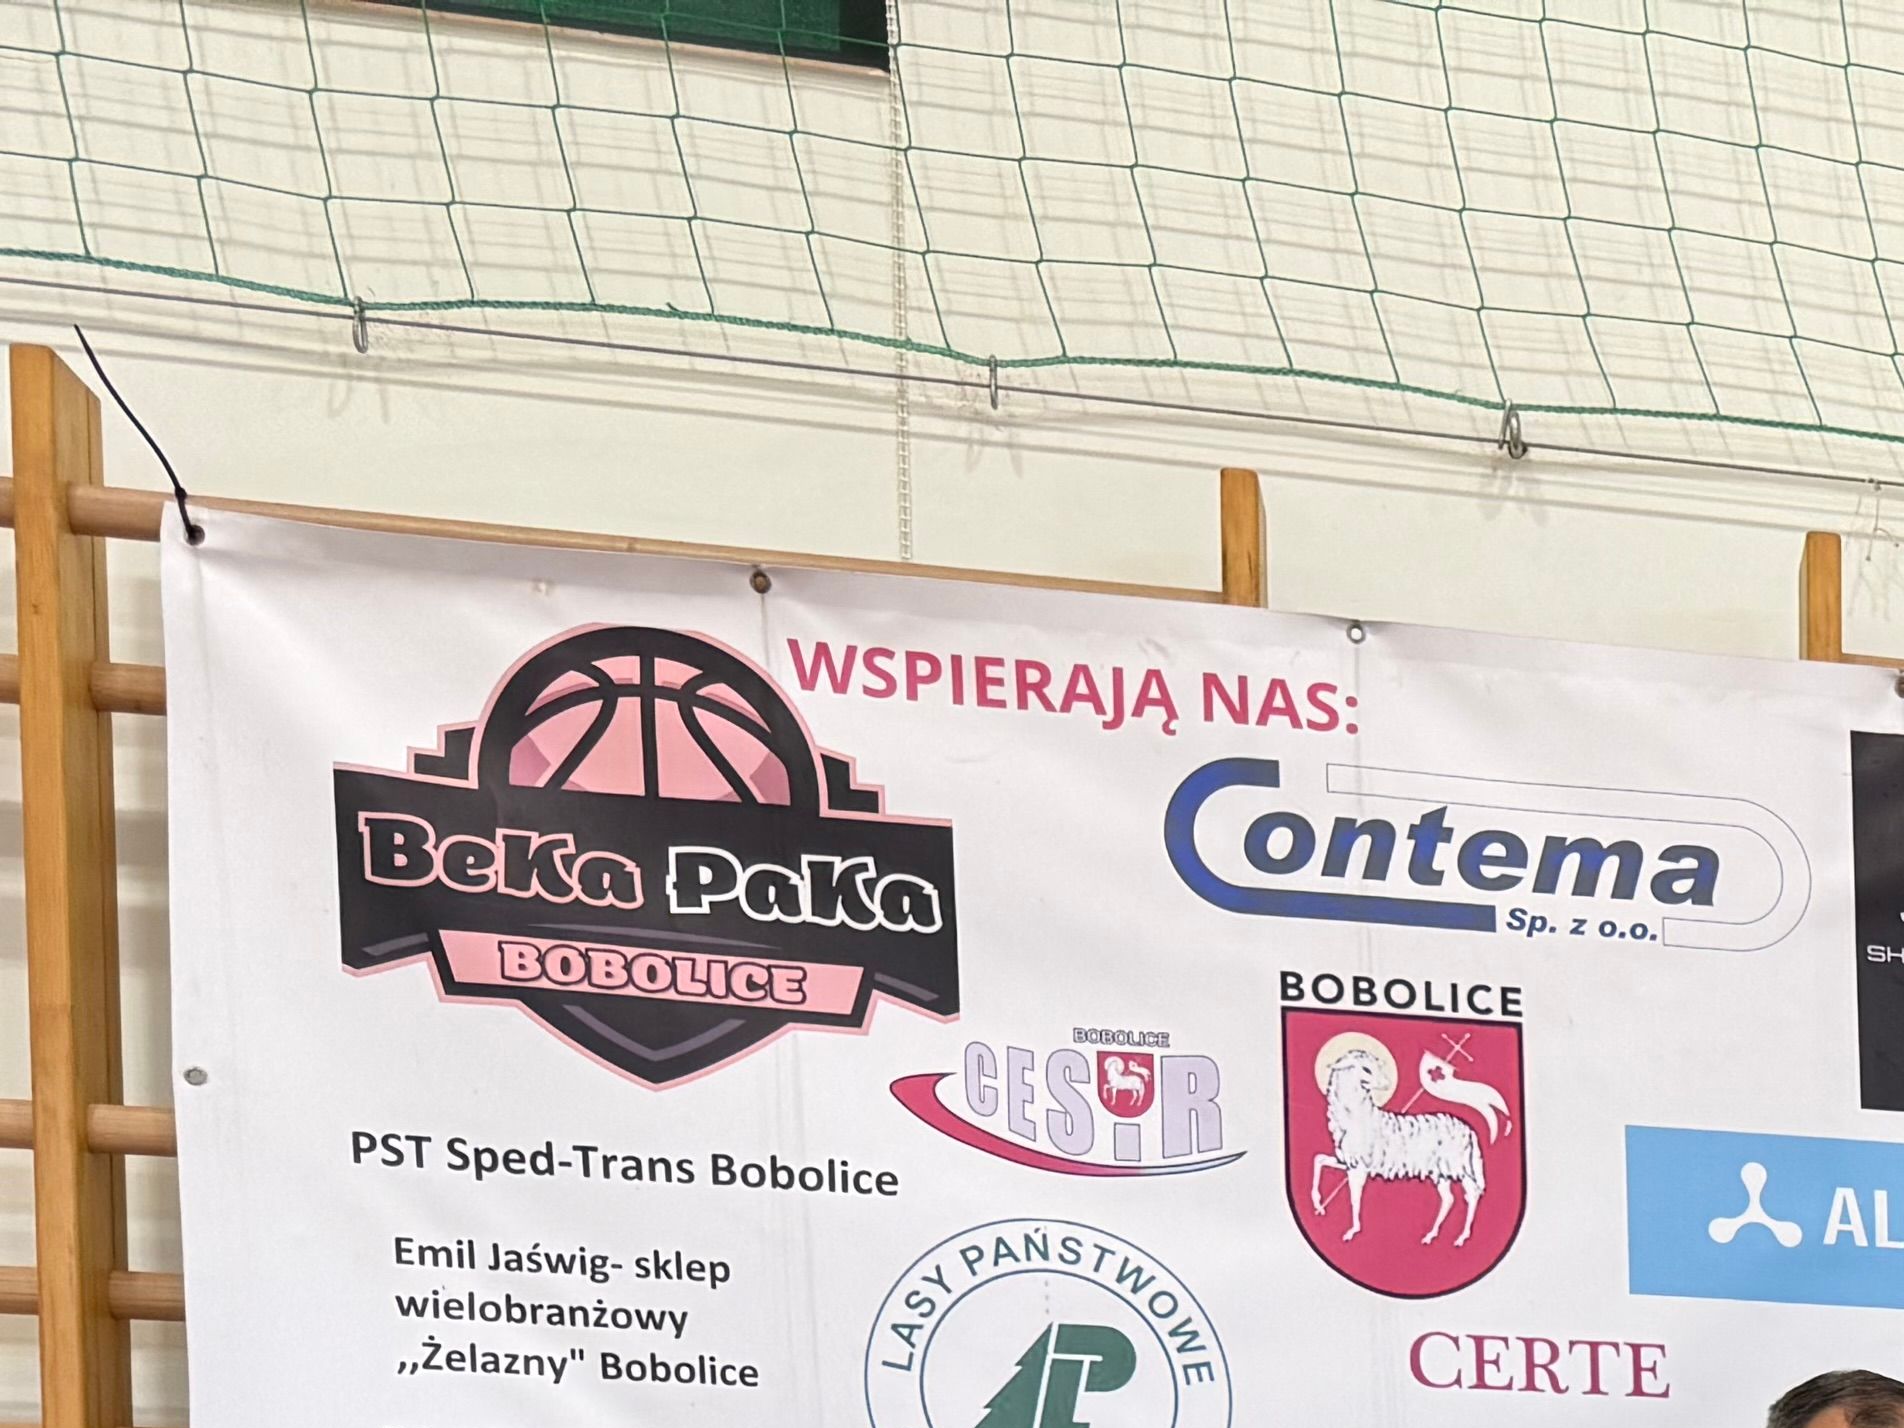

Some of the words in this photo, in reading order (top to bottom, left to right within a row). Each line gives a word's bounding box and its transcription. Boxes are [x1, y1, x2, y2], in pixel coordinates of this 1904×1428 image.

[787, 638, 1179, 736] WSPIERAJĄ
[1202, 672, 1358, 735] NAS:
[356, 810, 643, 911] BeKa
[664, 844, 943, 933] PaKa
[1163, 756, 1720, 932] Contema
[1505, 907, 1557, 938] Sp.
[1569, 918, 1588, 936] z
[1598, 920, 1658, 942] o.o.
[498, 938, 809, 1005] BOBOLICE
[1279, 970, 1523, 1019] BOBOLICE
[1073, 1027, 1171, 1048] BOBOLICE
[351, 1131, 432, 1169] PST
[446, 1137, 695, 1184] Sped-Trans
[711, 1153, 899, 1197] Bobolice
[394, 1236, 476, 1270] Emil
[487, 1242, 623, 1284] Jaświg-
[634, 1249, 731, 1290] sklep
[394, 1291, 689, 1340] wielobranżowy
[882, 1265, 953, 1372] LASY
[959, 1227, 1215, 1386] PAŃSTWOWE
[600, 1351, 759, 1387] Bobolice
[1409, 1331, 1670, 1398] CERTE
